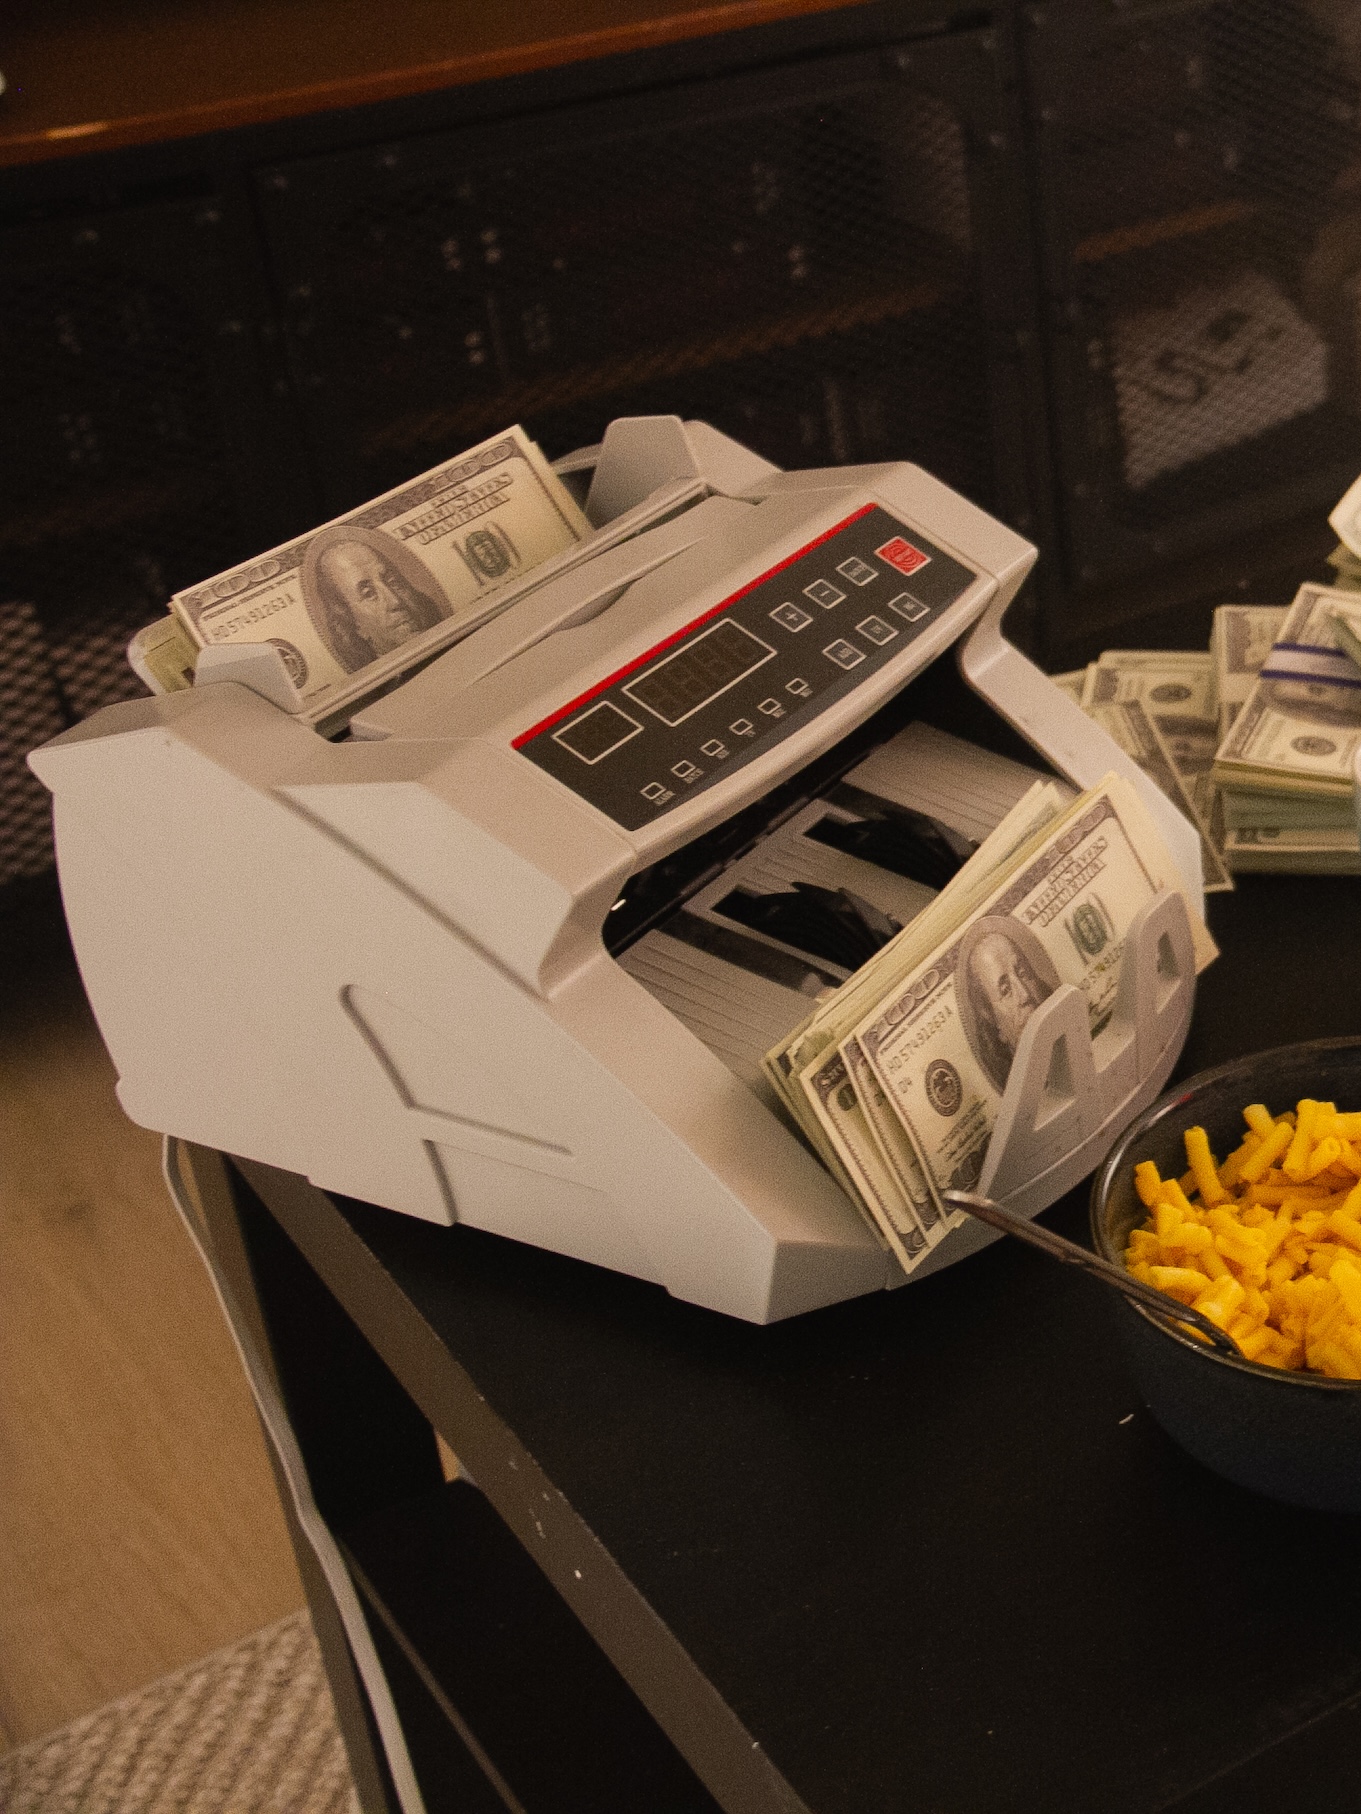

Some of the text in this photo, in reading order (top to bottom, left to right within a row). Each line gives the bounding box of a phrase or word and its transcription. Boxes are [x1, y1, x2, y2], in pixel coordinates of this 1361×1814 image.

[426, 438, 515, 496] 100
[450, 469, 515, 512] STATES
[191, 552, 282, 613] 100
[866, 966, 945, 1043] 100
